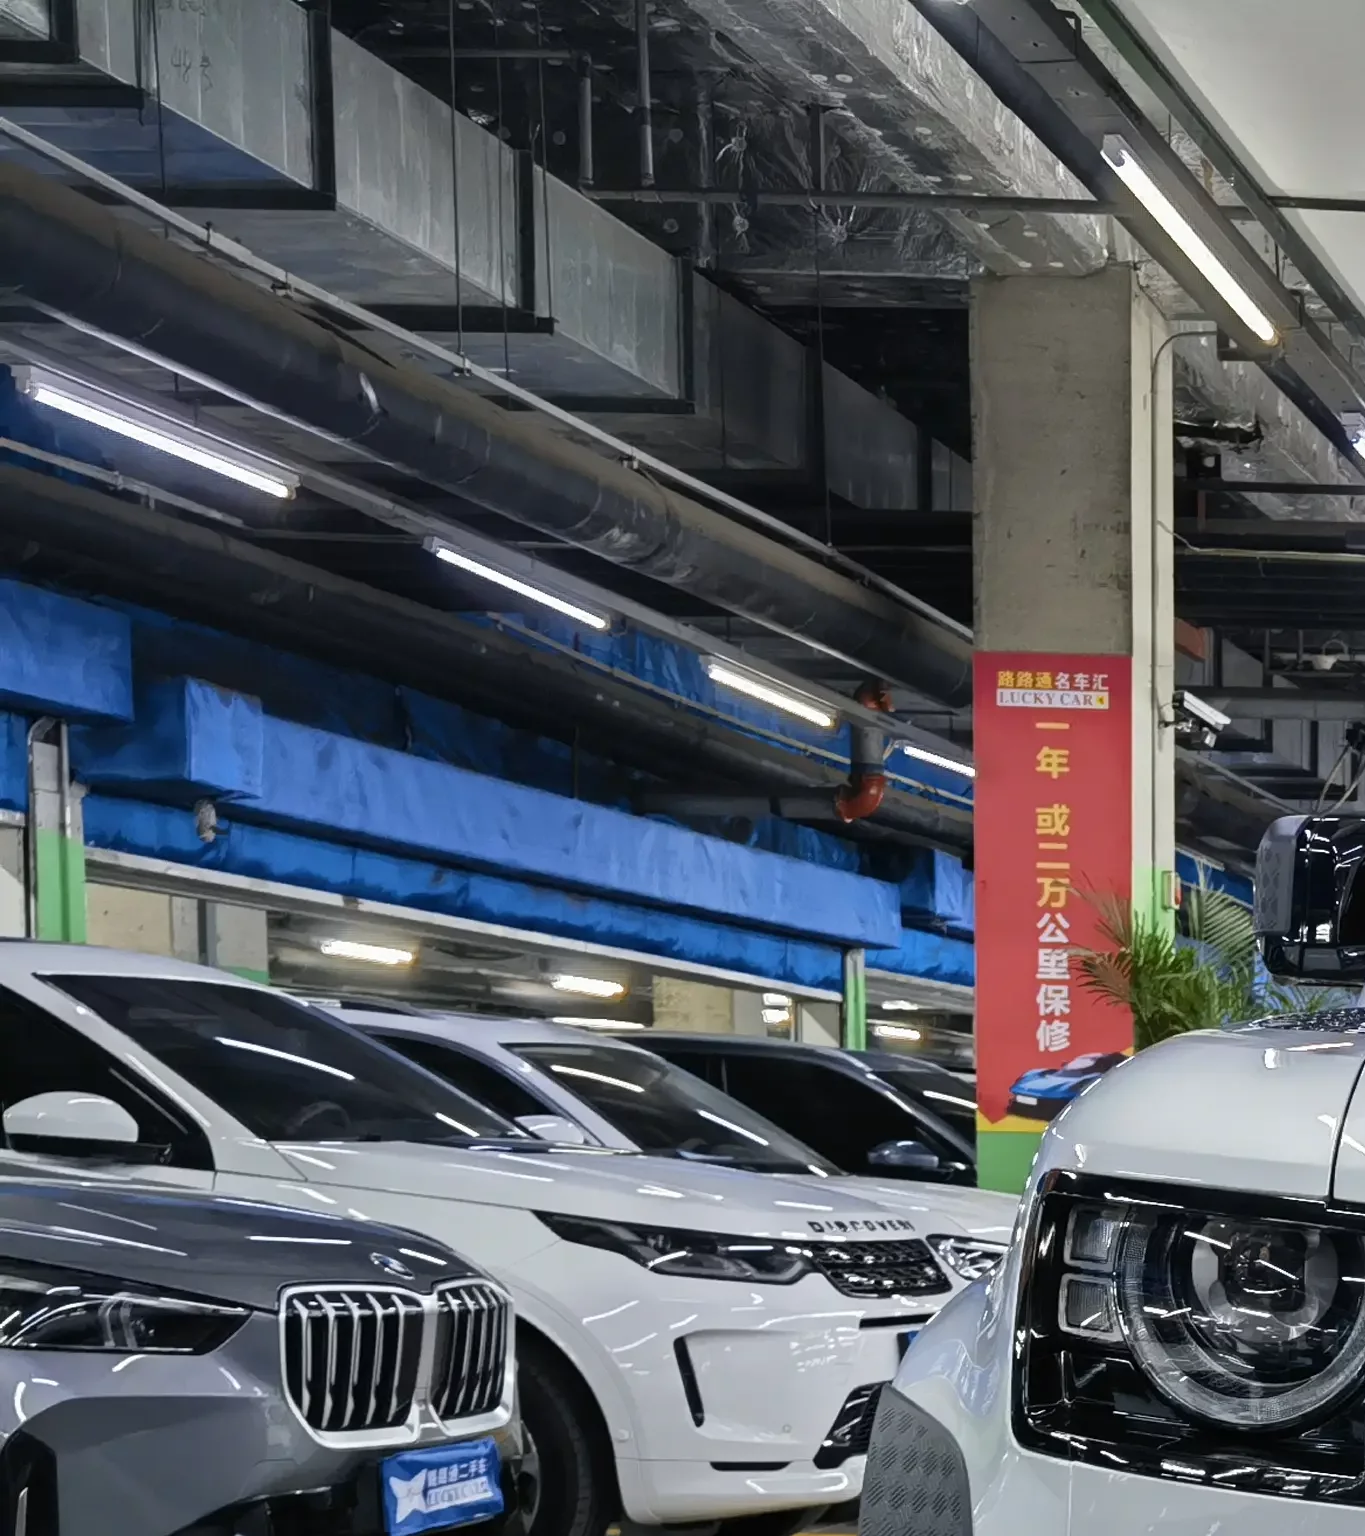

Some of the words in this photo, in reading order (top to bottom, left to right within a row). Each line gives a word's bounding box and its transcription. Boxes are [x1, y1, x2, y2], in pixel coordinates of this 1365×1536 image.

[998, 671, 1109, 690] 路路通名车汇
[1000, 691, 1055, 705] LUCKY
[1060, 692, 1093, 706] CAR
